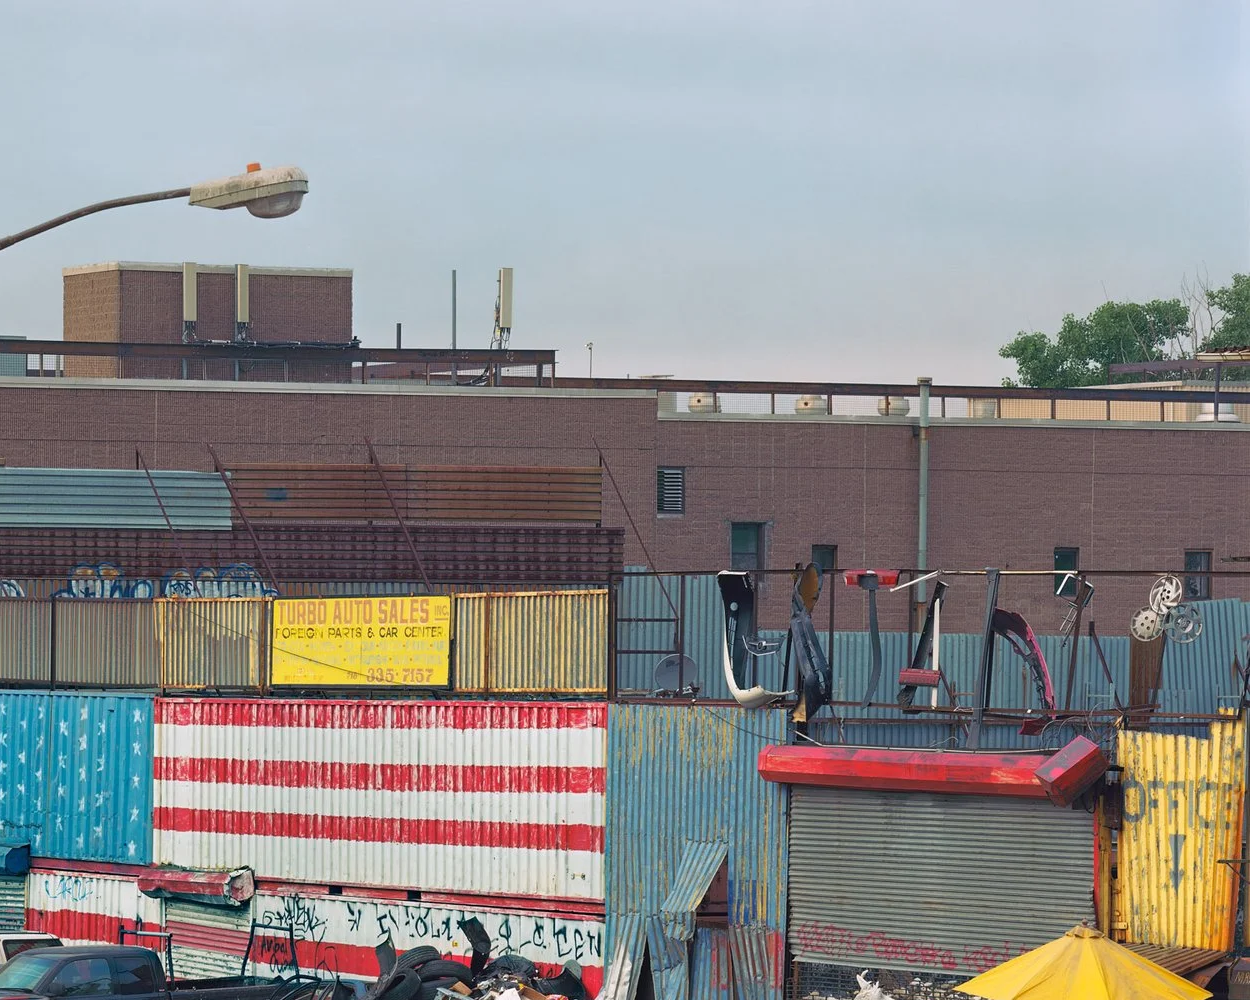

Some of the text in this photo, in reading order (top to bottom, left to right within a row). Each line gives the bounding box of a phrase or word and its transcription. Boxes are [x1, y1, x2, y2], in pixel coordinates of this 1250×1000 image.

[277, 600, 327, 626] TURBO
[332, 599, 373, 625] AUTO
[378, 598, 430, 625] SALES
[327, 627, 362, 638] PARTS
[367, 627, 375, 638] &
[379, 627, 398, 638] CAR
